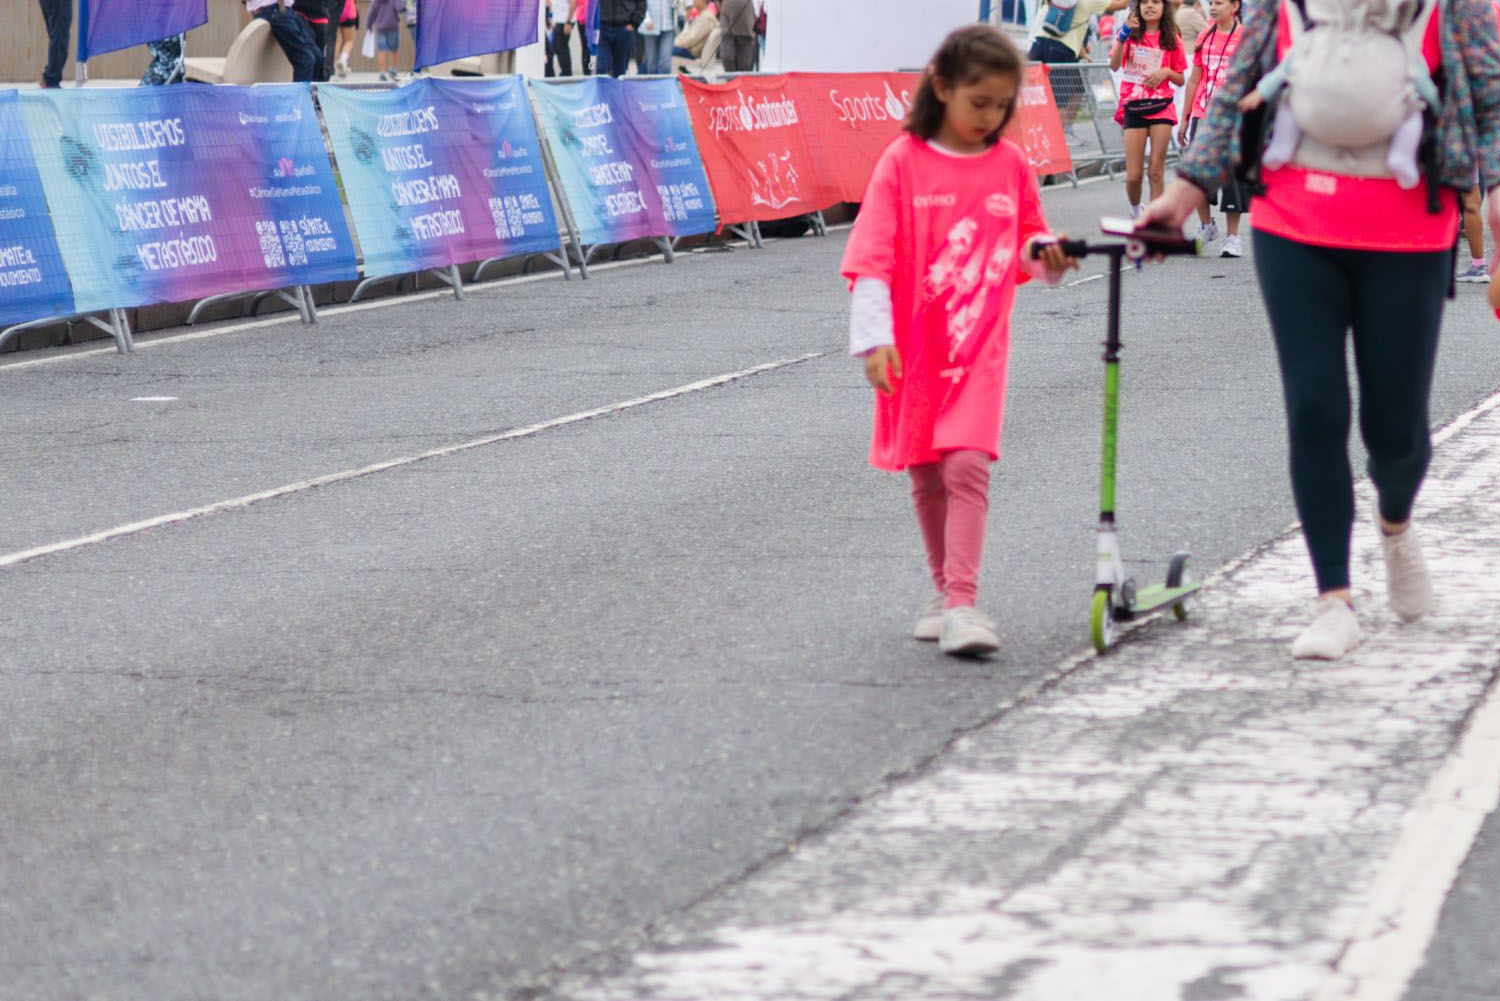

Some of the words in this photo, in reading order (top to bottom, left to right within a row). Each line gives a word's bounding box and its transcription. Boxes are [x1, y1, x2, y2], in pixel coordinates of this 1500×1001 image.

[708, 102, 744, 141] Sports
[749, 94, 799, 128] Santander
[830, 89, 887, 128] Sports
[93, 118, 185, 151] VISIBILICEMOS
[416, 144, 433, 168] EL
[104, 162, 150, 190] JUNTOS
[149, 160, 167, 187] EL
[116, 197, 164, 231] CÁNCER
[162, 199, 180, 226] DE
[178, 195, 212, 225] MAMA
[136, 231, 217, 271] METASTÁSICO
